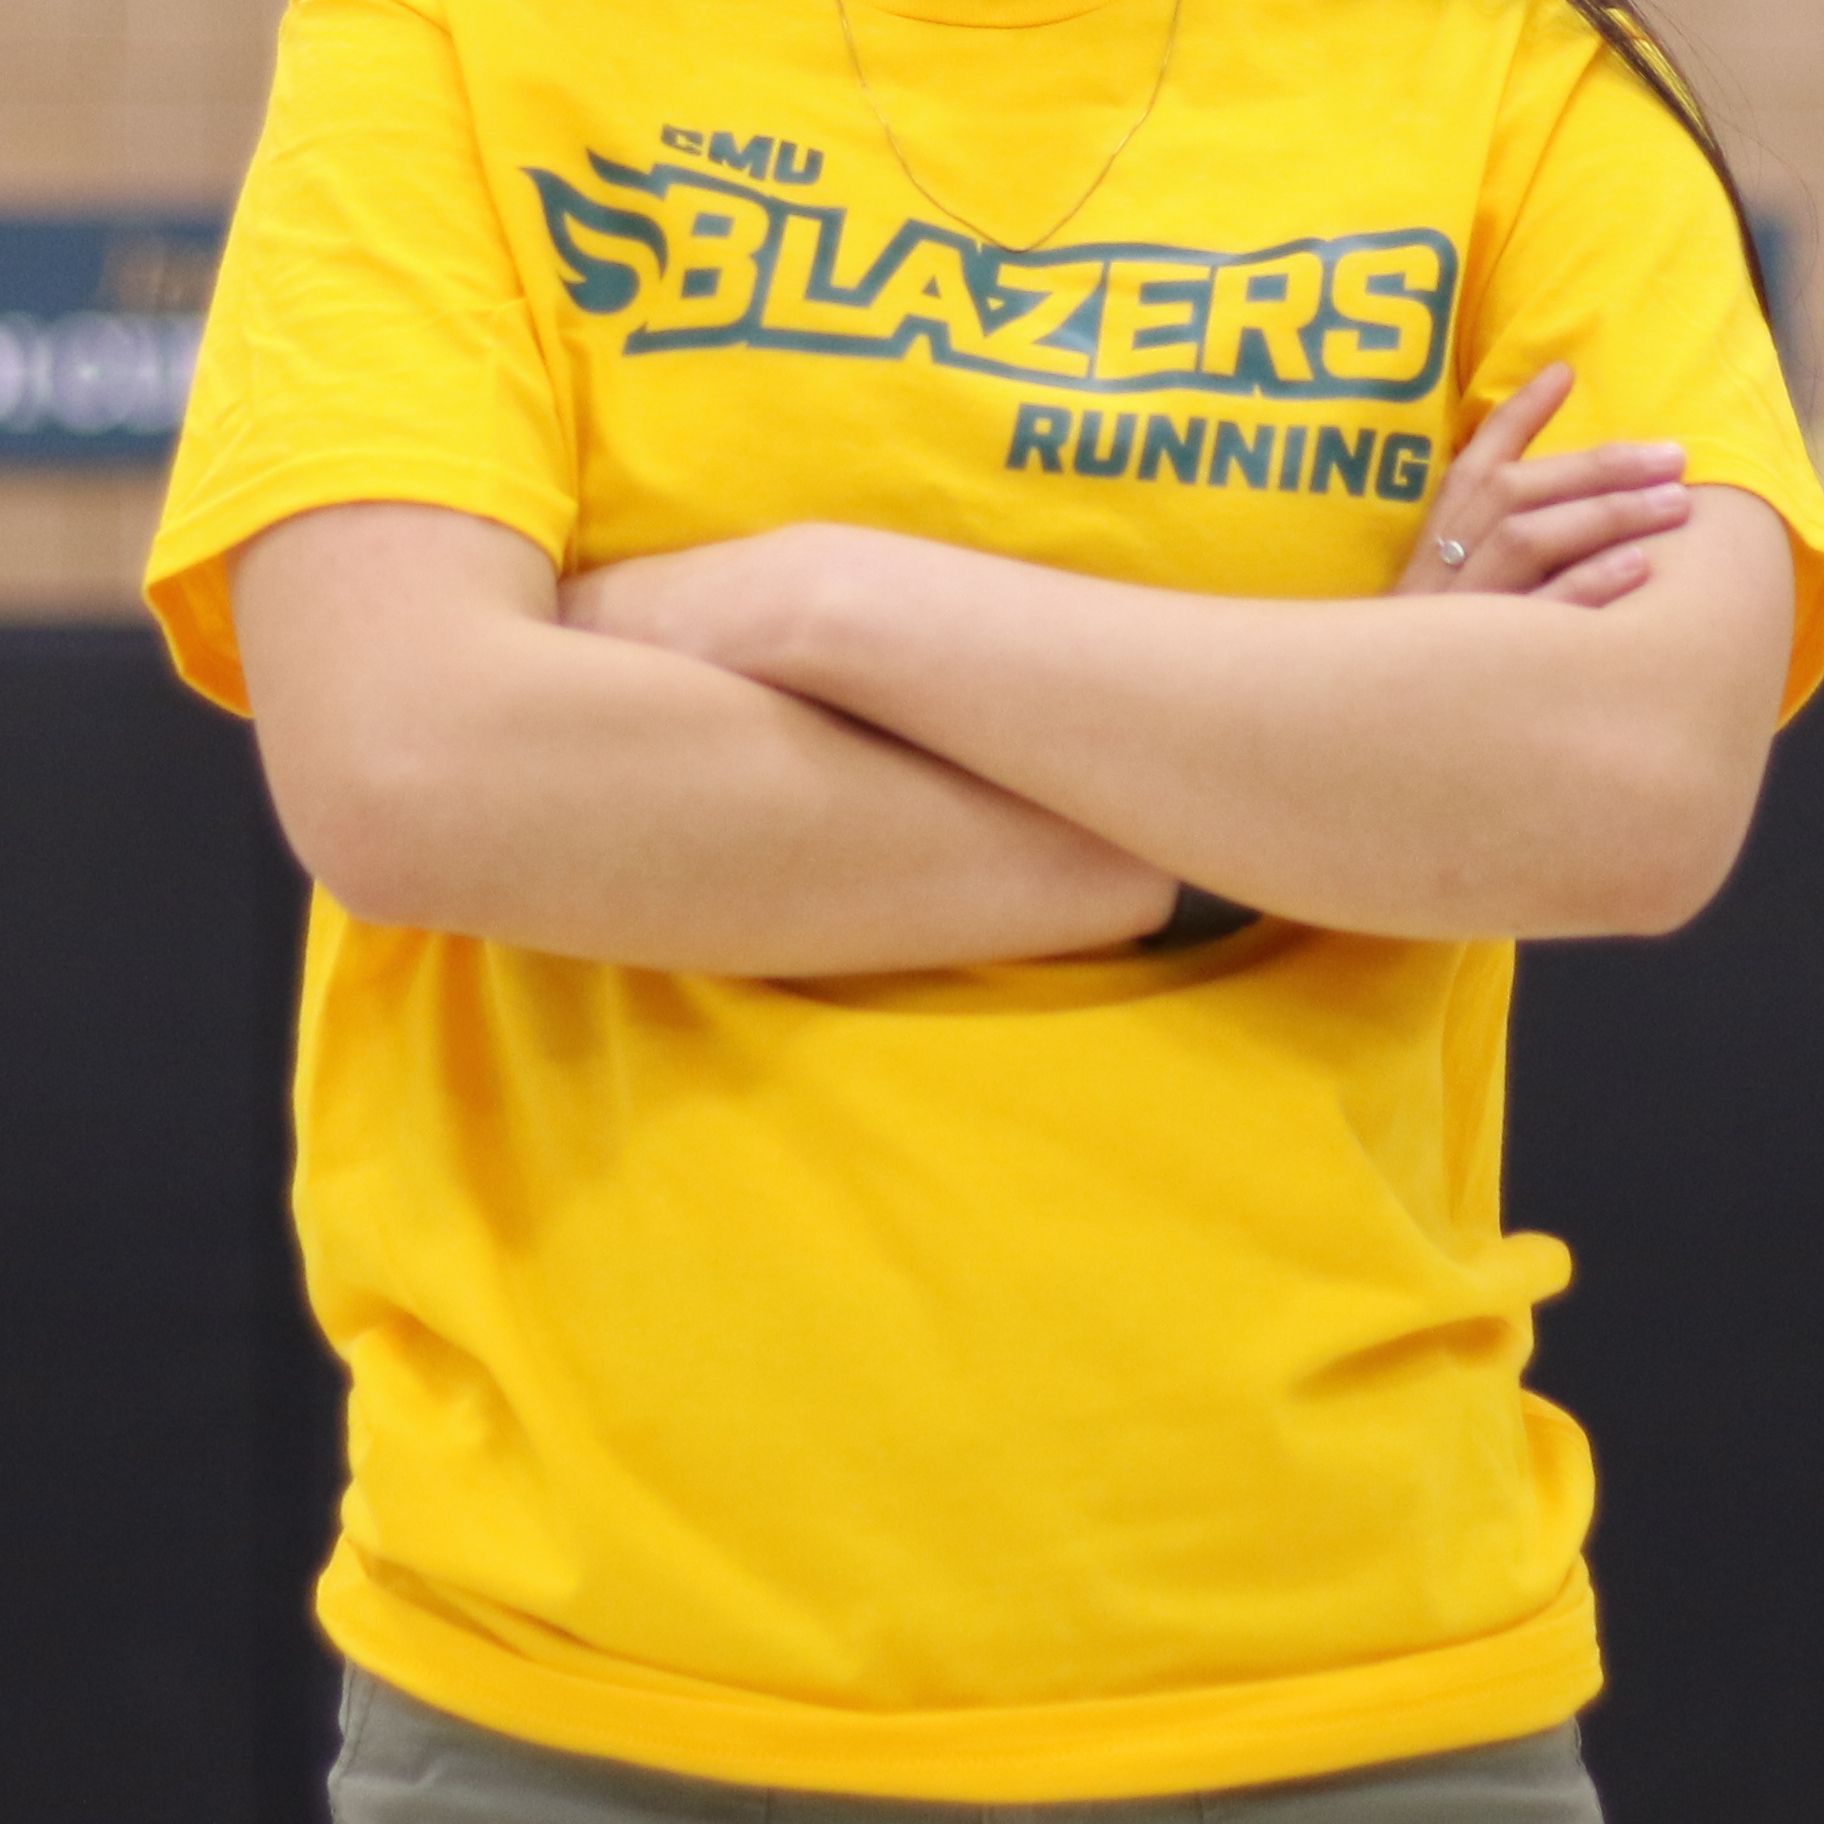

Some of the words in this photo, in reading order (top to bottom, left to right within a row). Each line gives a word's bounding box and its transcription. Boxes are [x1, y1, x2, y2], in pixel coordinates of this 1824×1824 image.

[660, 125, 824, 187] CMU
[631, 171, 1456, 400] BLAZERS
[1004, 403, 1433, 504] RUNNING
